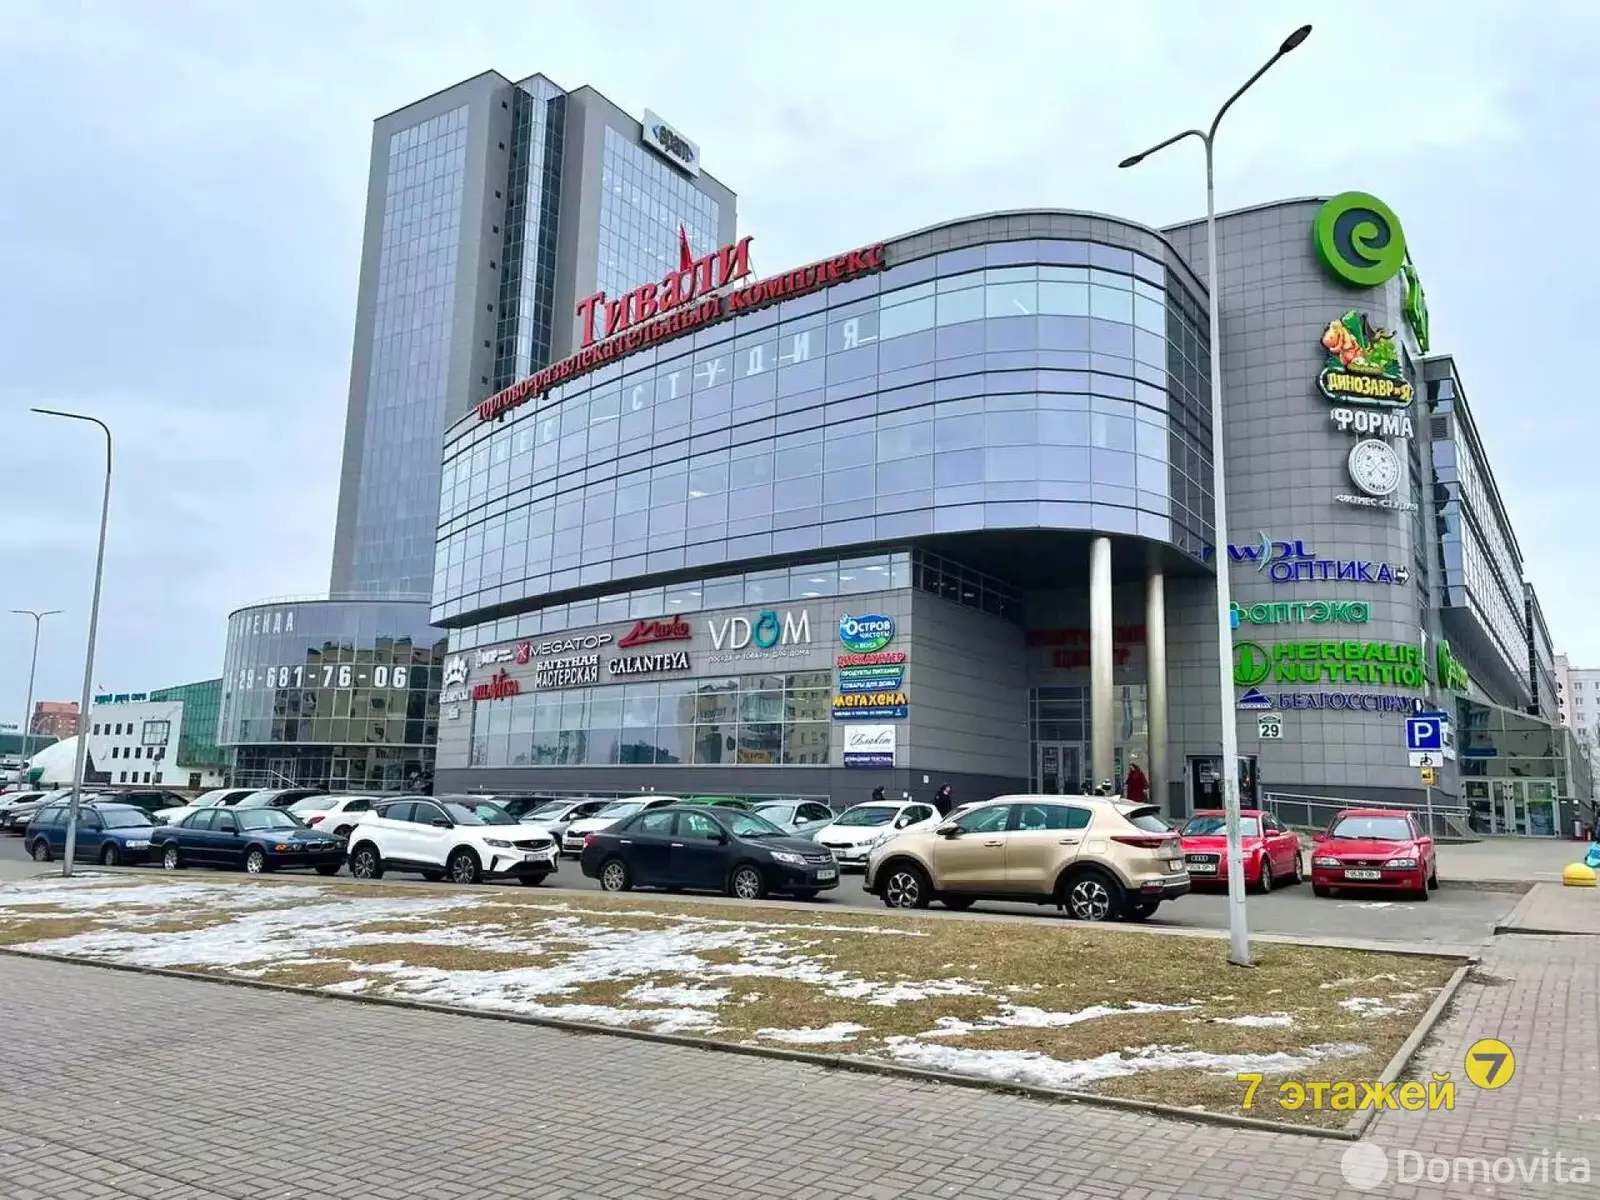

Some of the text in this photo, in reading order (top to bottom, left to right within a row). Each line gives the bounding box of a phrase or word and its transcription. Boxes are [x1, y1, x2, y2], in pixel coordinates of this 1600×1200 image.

[576, 234, 753, 348] Тивали
[1330, 407, 1415, 438] ФОРМА
[1271, 561, 1396, 583] ОПТИКА
[708, 610, 812, 650] VDOM
[530, 633, 613, 656] MEGATOP
[536, 655, 599, 672] БАГЕТНАЯ
[608, 652, 690, 675] GALANTEYA
[535, 665, 599, 689] МАСТЕРСКАЯ
[1261, 725, 1279, 737] 29
[1413, 722, 1433, 747] P
